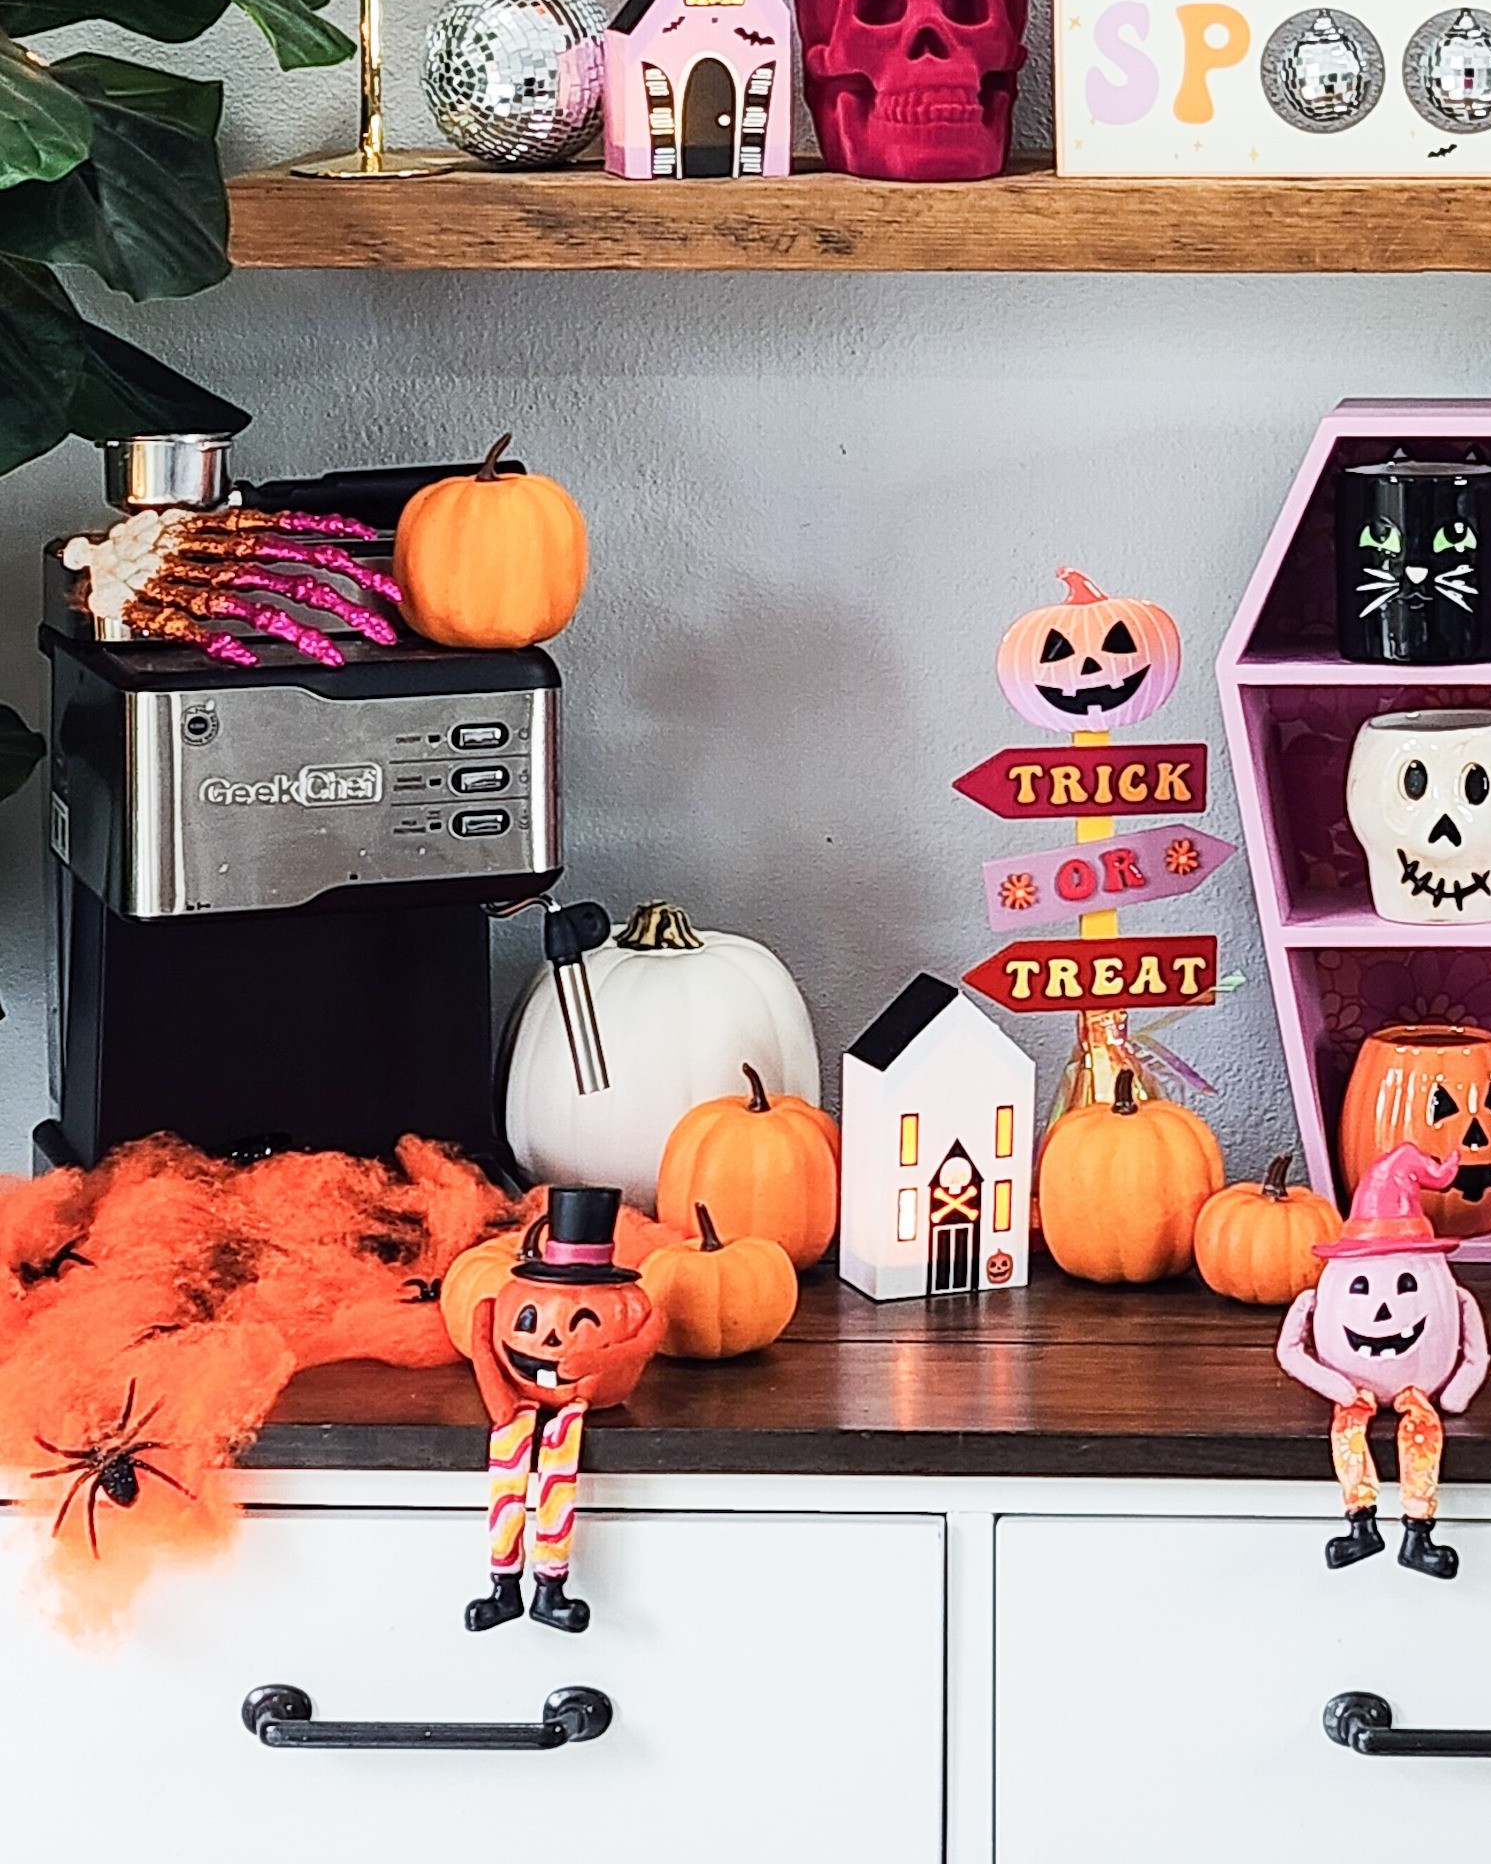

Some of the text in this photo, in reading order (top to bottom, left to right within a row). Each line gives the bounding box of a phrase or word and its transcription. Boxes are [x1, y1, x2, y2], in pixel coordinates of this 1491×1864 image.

[1008, 763, 1192, 804] TRICK
[1055, 848, 1147, 902] OR
[1006, 956, 1207, 999] TREAT
